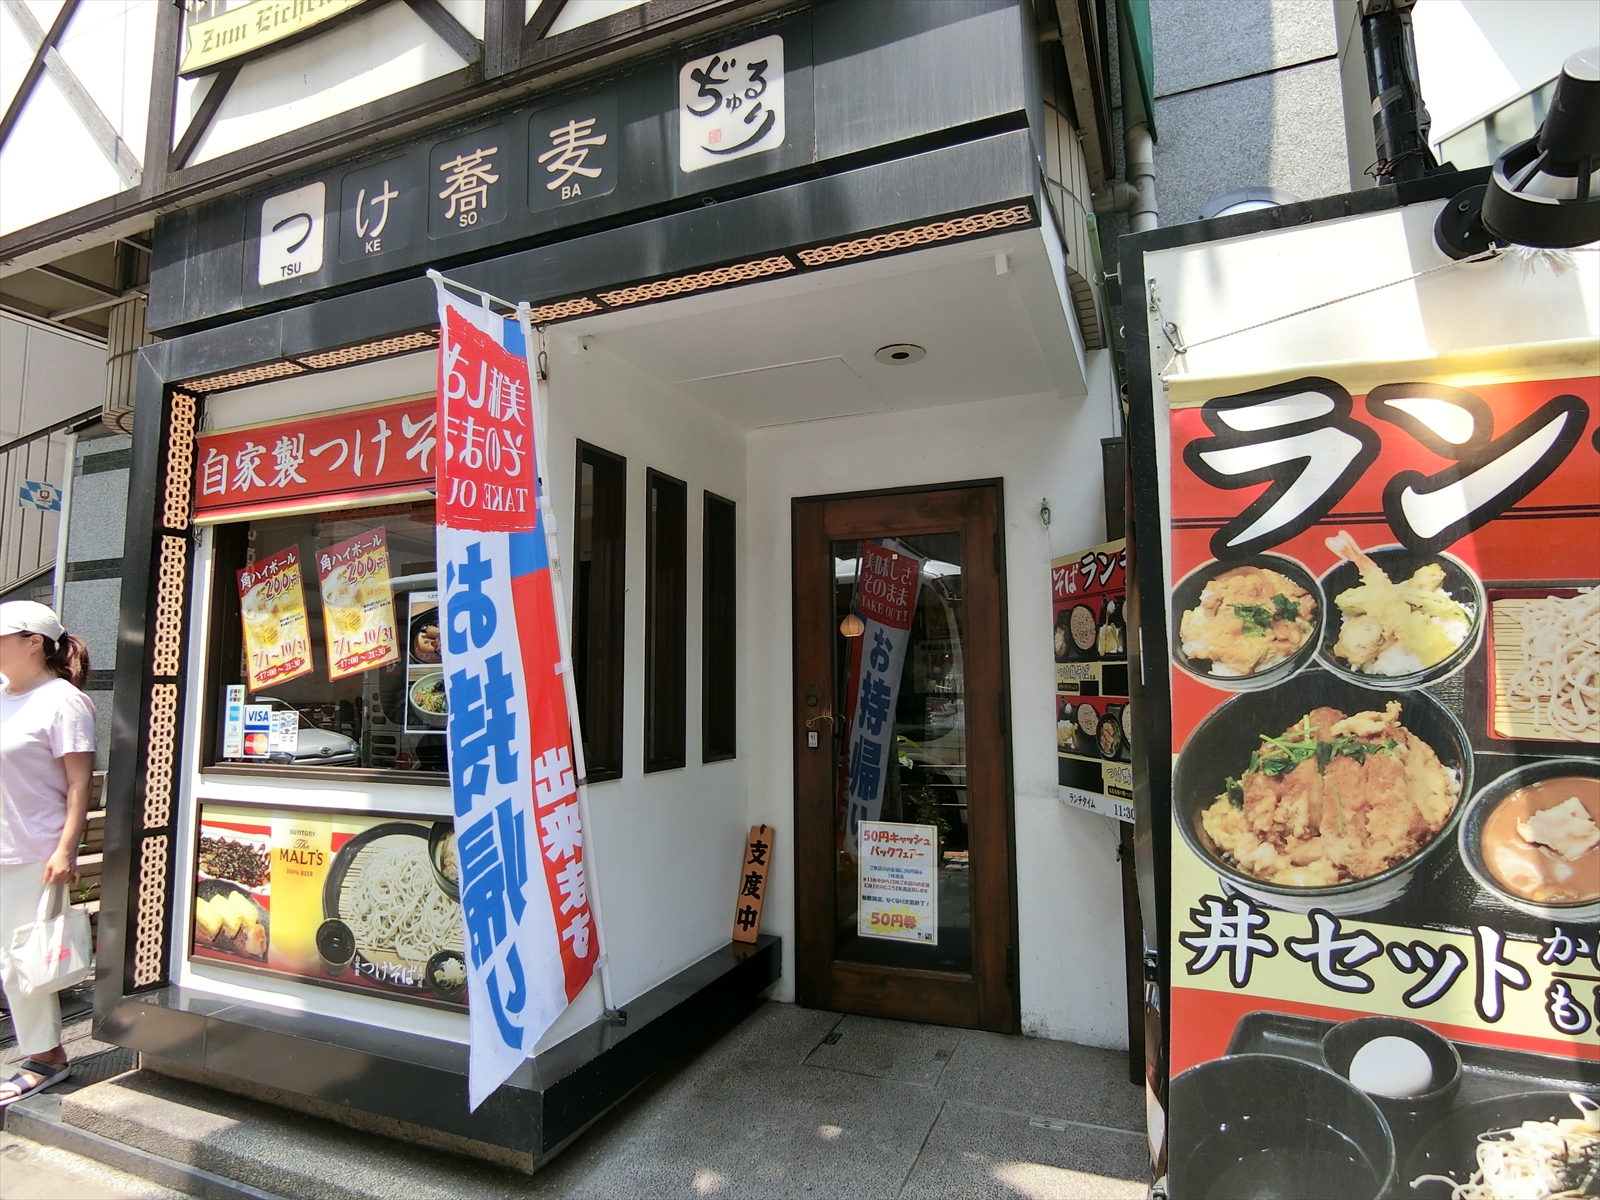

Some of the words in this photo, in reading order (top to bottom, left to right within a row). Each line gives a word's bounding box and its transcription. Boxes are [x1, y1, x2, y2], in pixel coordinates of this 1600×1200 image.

[200, 22, 248, 54] Zum
[280, 262, 302, 278] TSU
[365, 239, 382, 254] KE
[458, 212, 478, 228] SO
[561, 183, 582, 200] BA
[1184, 377, 1600, 560] ラン
[320, 534, 383, 573] 角ハイボール
[240, 552, 297, 591] 角ハイボール
[345, 555, 386, 584] 200円
[264, 573, 300, 600] 200円
[863, 571, 909, 607] そのまま
[861, 594, 884, 614] TAKE
[248, 711, 269, 722] VISA
[1069, 792, 1096, 809] ランチタイム
[289, 829, 316, 837] SUNTORY
[293, 838, 310, 850] The
[863, 829, 931, 846] 50円キャッシュ
[279, 848, 324, 866] MALT'S
[286, 868, 299, 876] 100%
[736, 839, 769, 932] 支度中
[871, 911, 917, 930] 50円券
[1537, 923, 1600, 971] か
[361, 961, 418, 986] つけそば
[1545, 979, 1600, 1036] も
